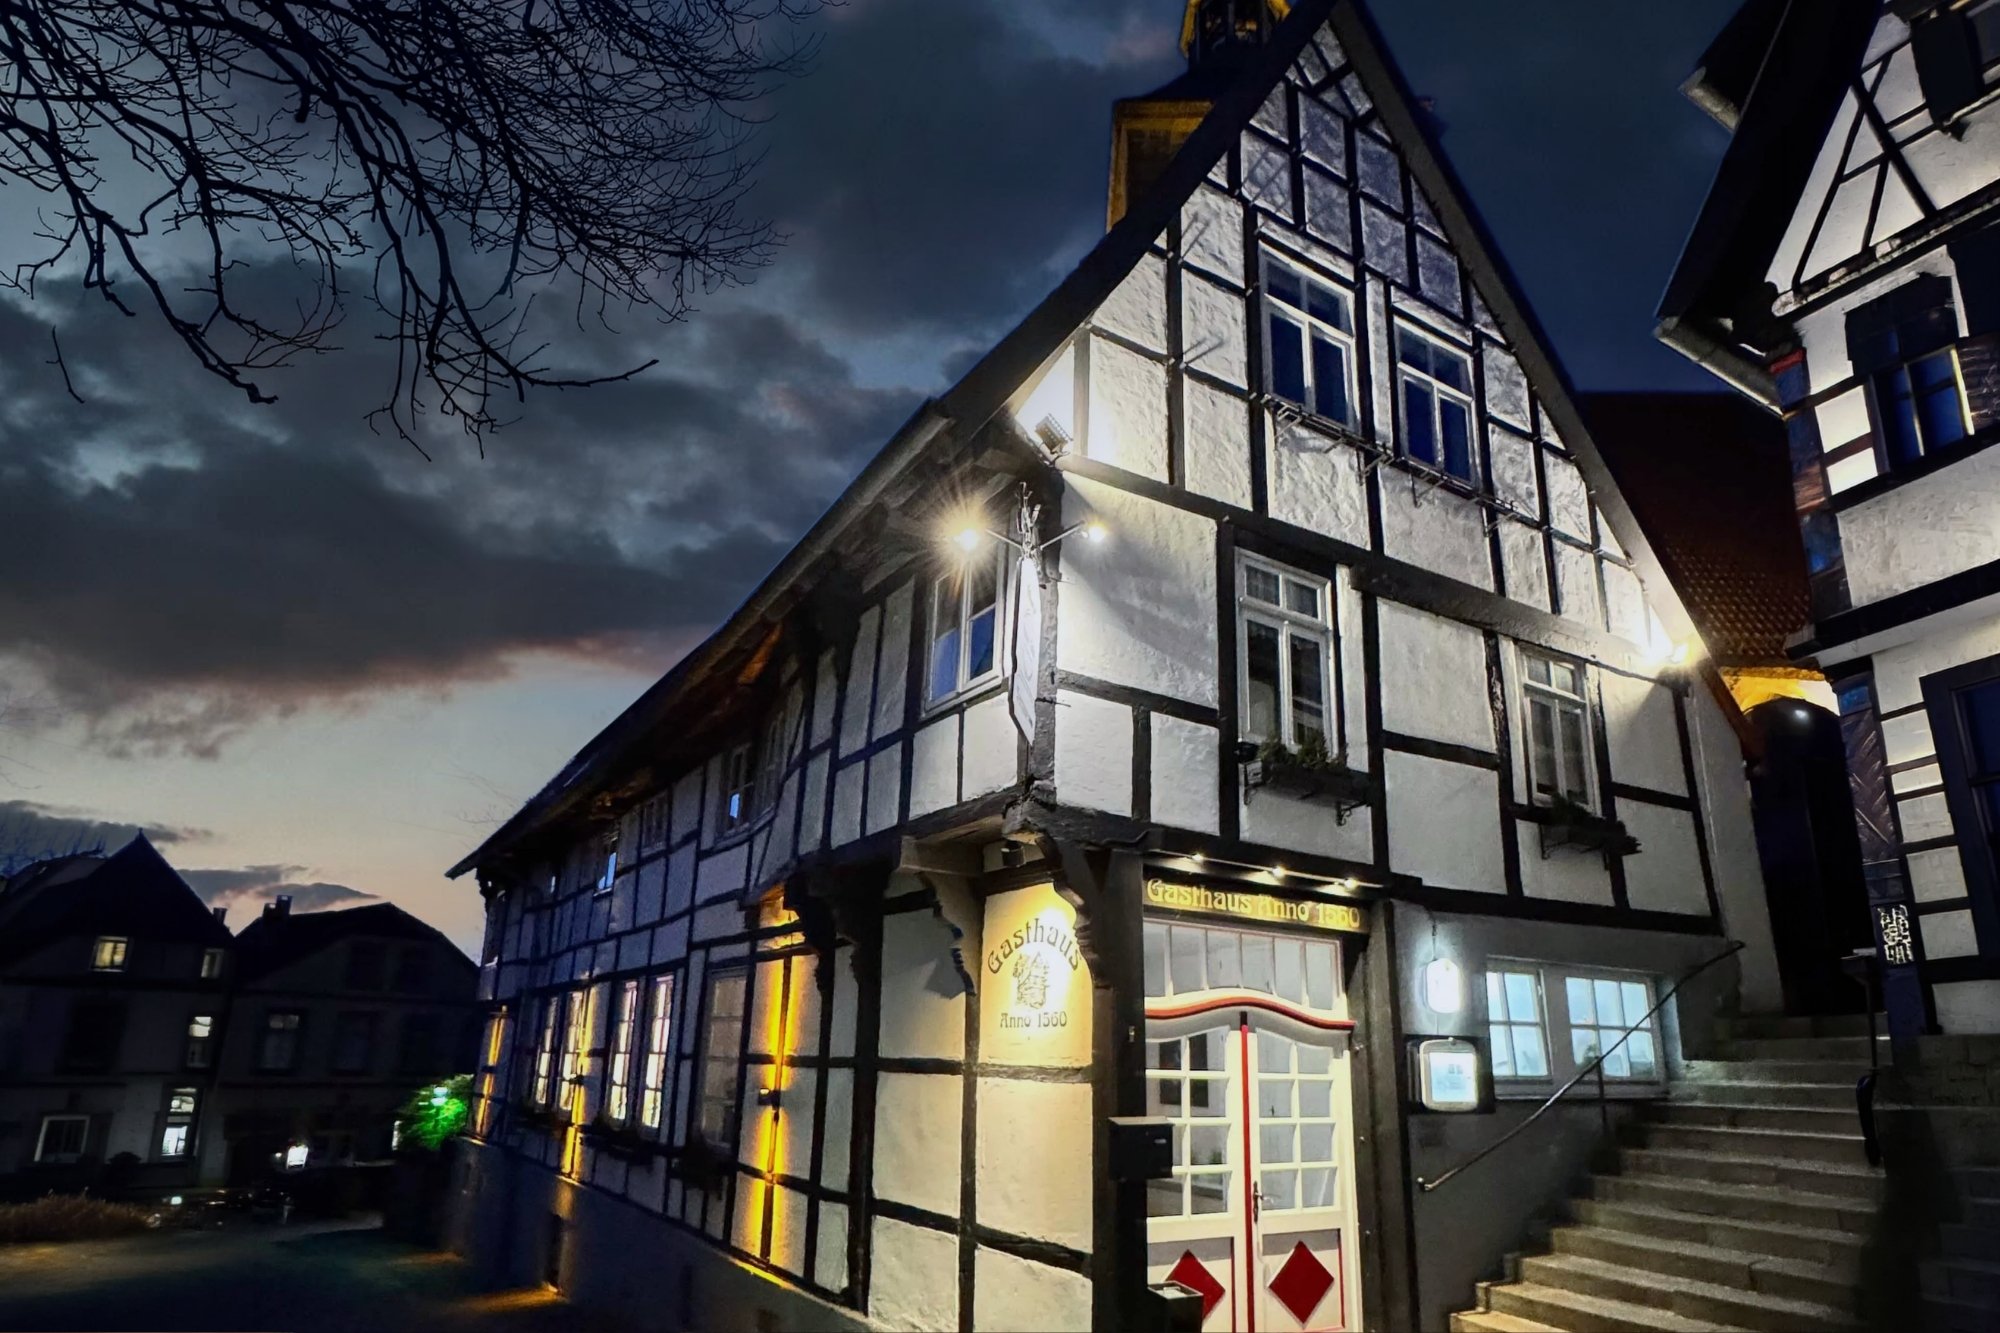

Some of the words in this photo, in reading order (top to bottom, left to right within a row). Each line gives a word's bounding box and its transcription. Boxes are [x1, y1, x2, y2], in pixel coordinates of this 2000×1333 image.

[1147, 878, 1252, 915] Gasthaus
[1258, 893, 1310, 921] Anno
[1316, 902, 1360, 928] 1560
[988, 918, 1078, 974] Gasthaus
[1000, 1013, 1031, 1028] Anno
[1038, 1011, 1067, 1027] 1560
